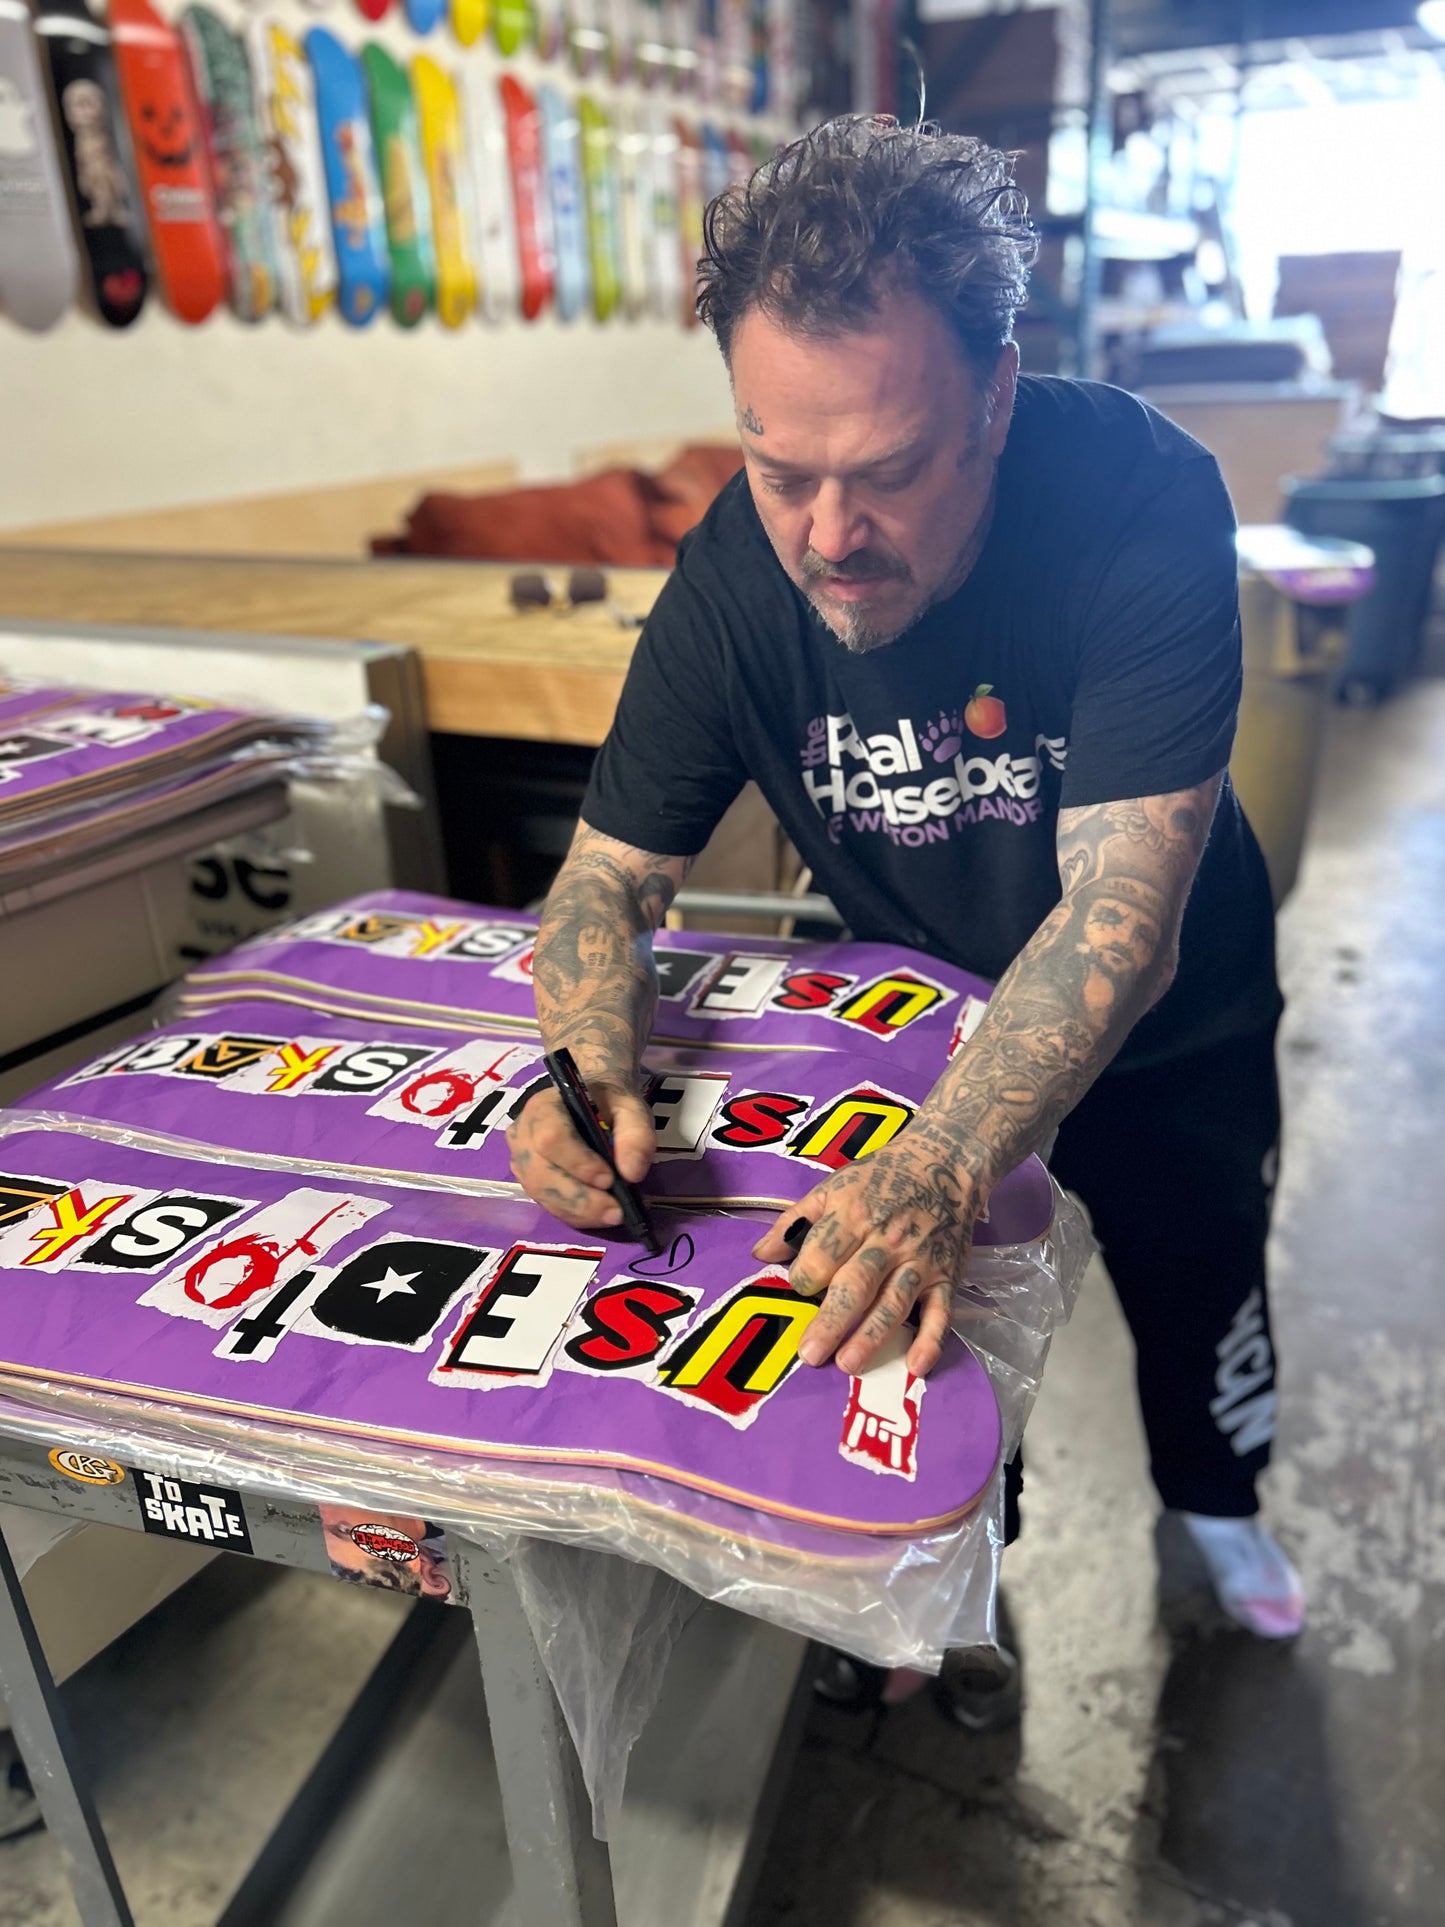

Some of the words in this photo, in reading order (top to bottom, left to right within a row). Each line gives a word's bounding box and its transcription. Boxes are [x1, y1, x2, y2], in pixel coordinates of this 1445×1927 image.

[800, 716, 827, 767] the
[827, 713, 922, 776] Ral
[143, 1472, 184, 1503] TO
[144, 1494, 245, 1540] SKATE
